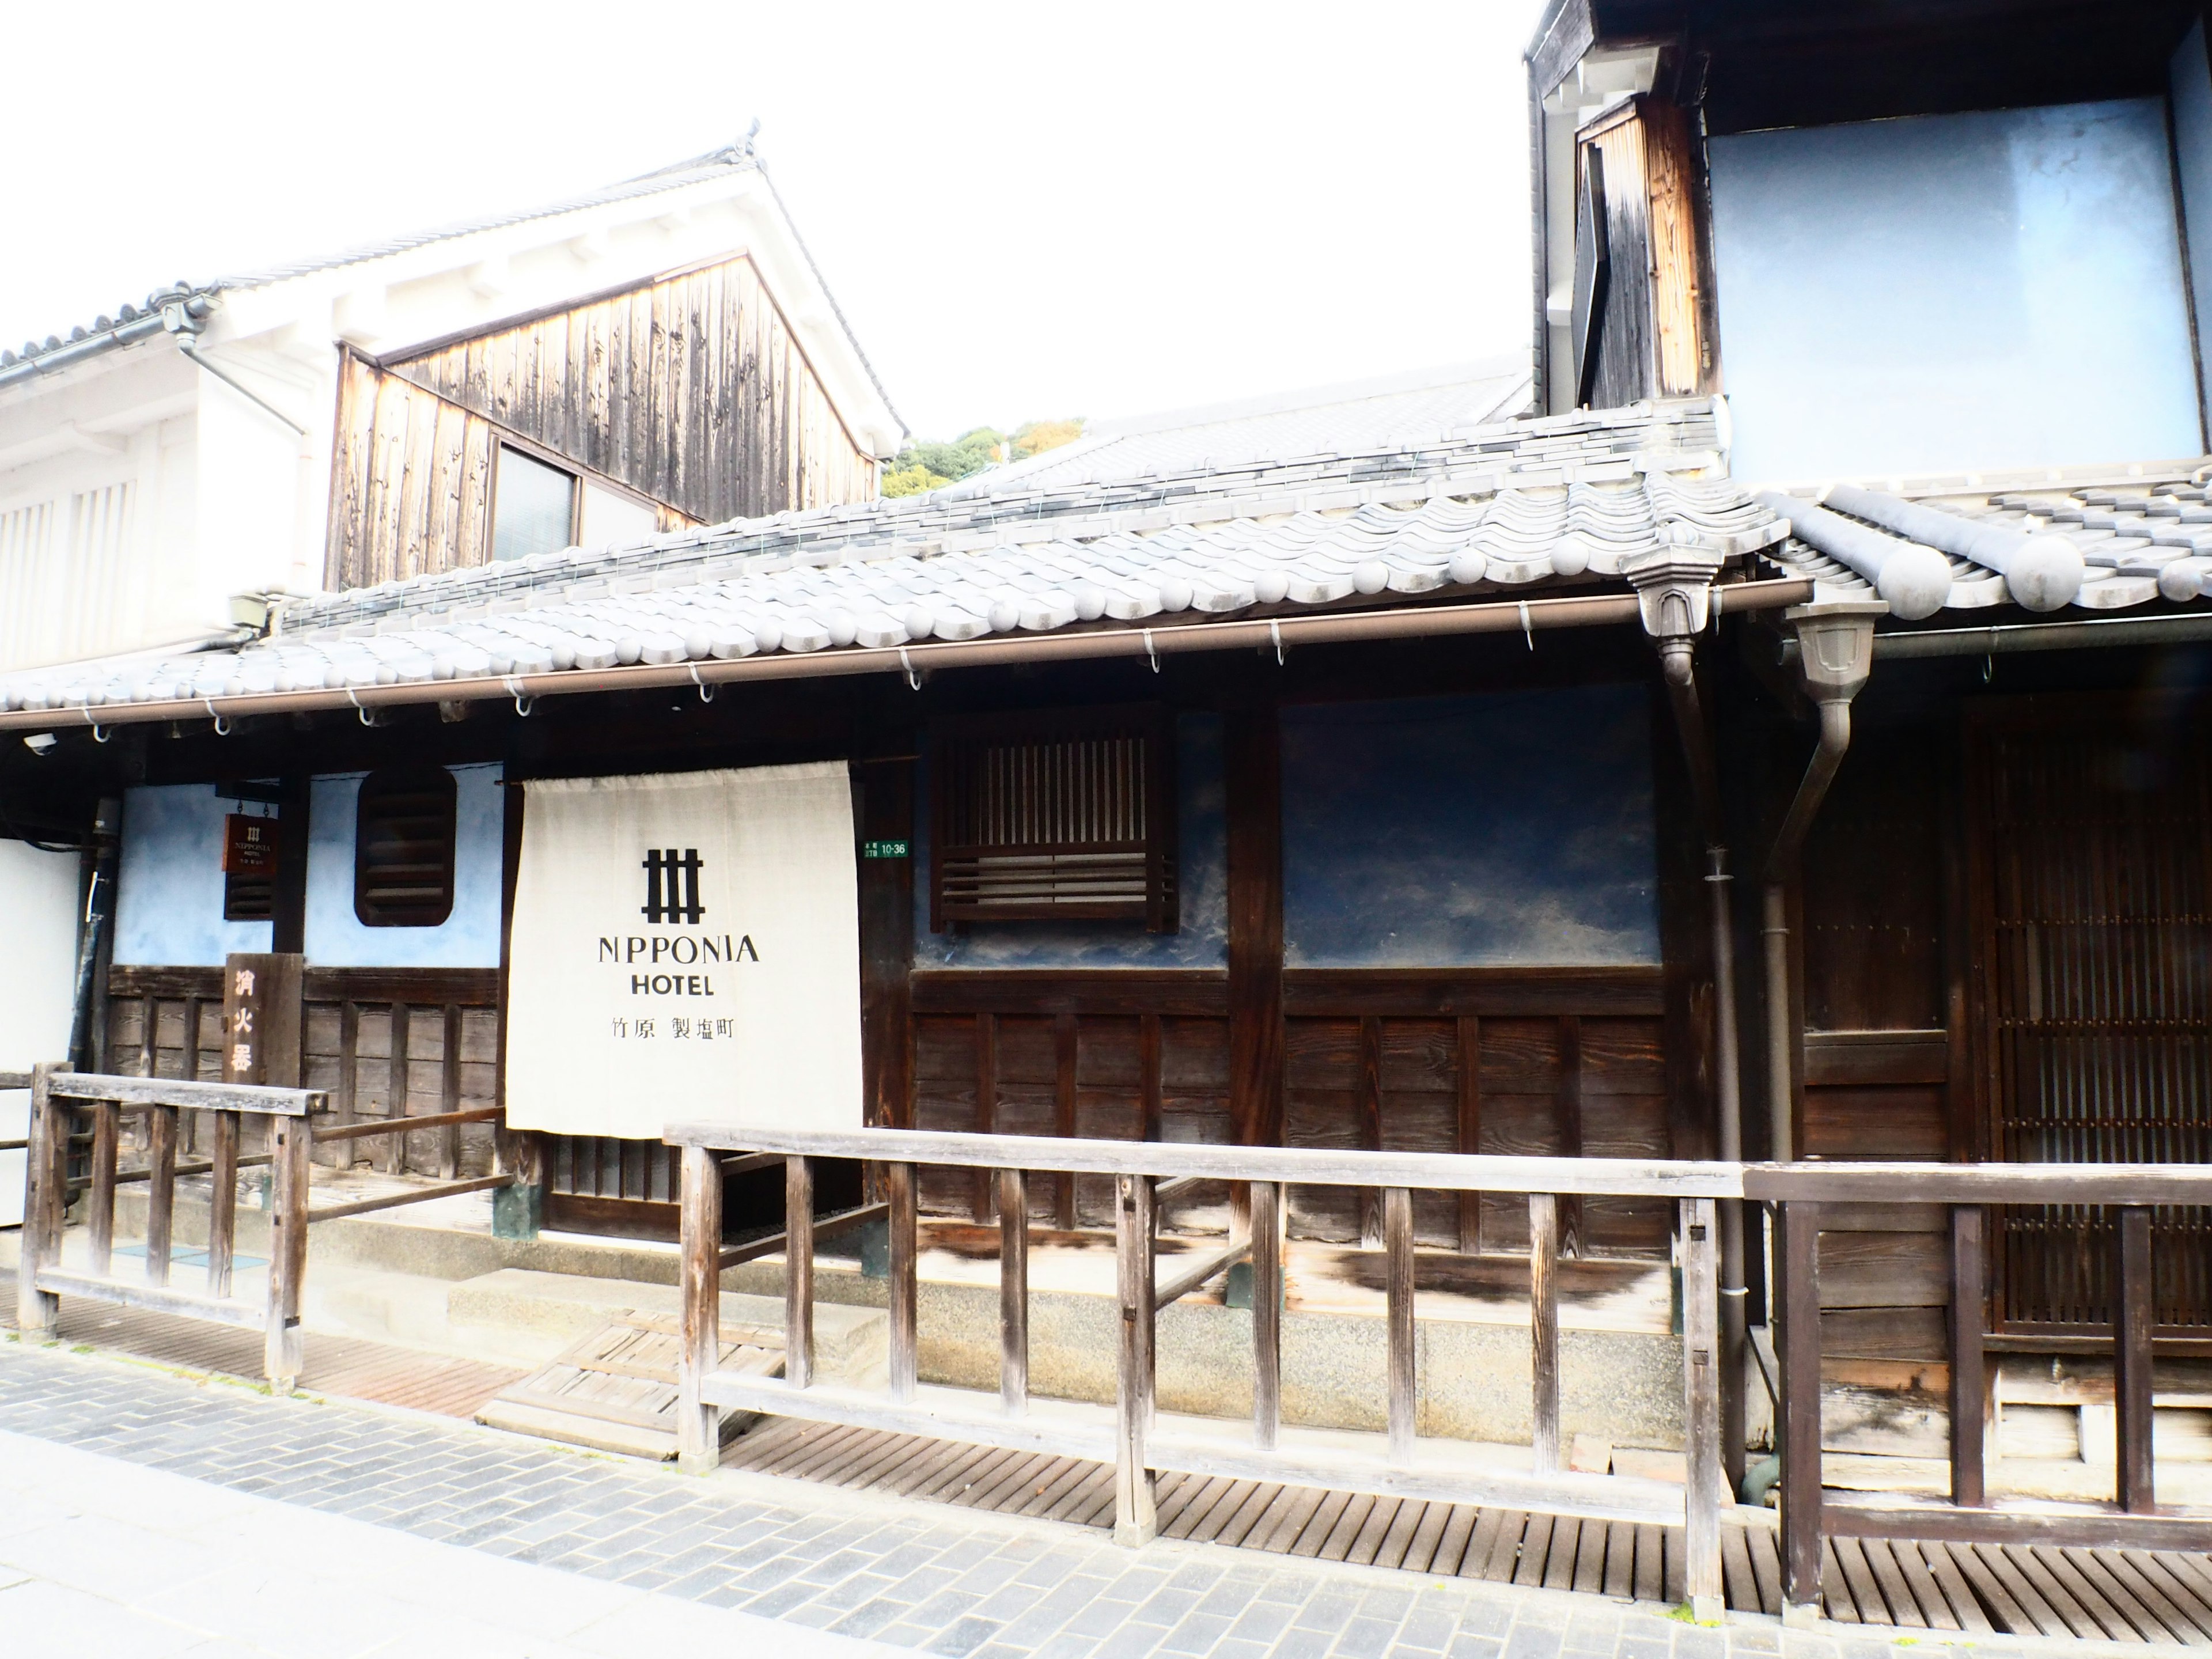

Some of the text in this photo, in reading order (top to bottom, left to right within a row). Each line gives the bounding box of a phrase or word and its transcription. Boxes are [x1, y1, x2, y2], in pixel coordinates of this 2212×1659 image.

[235, 842, 271, 853] NIPPONIA
[882, 844, 906, 854] 10-36
[632, 975, 714, 995] HOTEL
[231, 969, 255, 1071] 消火器
[611, 1017, 734, 1039] 竹原 製塩町
